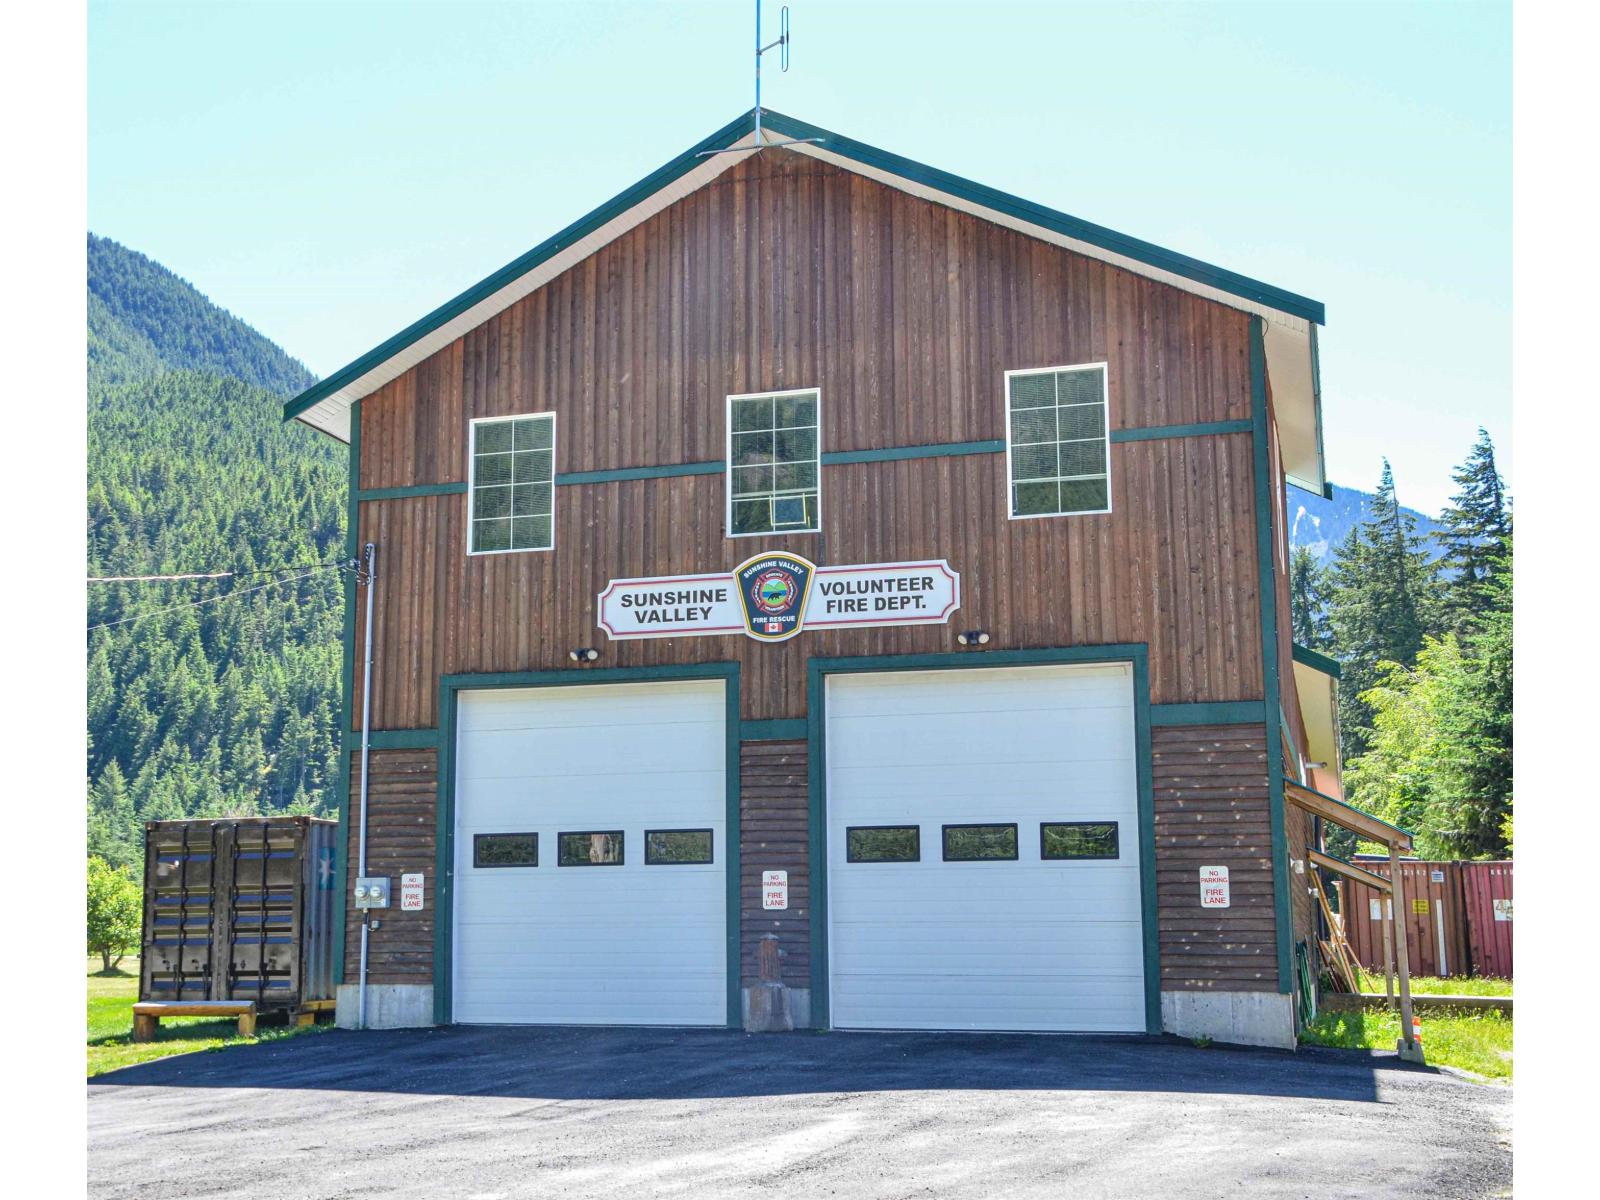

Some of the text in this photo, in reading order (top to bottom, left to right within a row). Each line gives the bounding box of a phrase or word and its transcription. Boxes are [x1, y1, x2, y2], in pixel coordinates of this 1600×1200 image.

[743, 560, 804, 579] SUNSHINE VALLEY
[819, 576, 934, 596] VOLUNTEER
[620, 588, 728, 608] SUNSHINE
[826, 595, 927, 614] FIRE DEPT.
[634, 606, 713, 624] VALLEY
[752, 615, 796, 624] FIRE RESCUE
[765, 899, 785, 907] LANE
